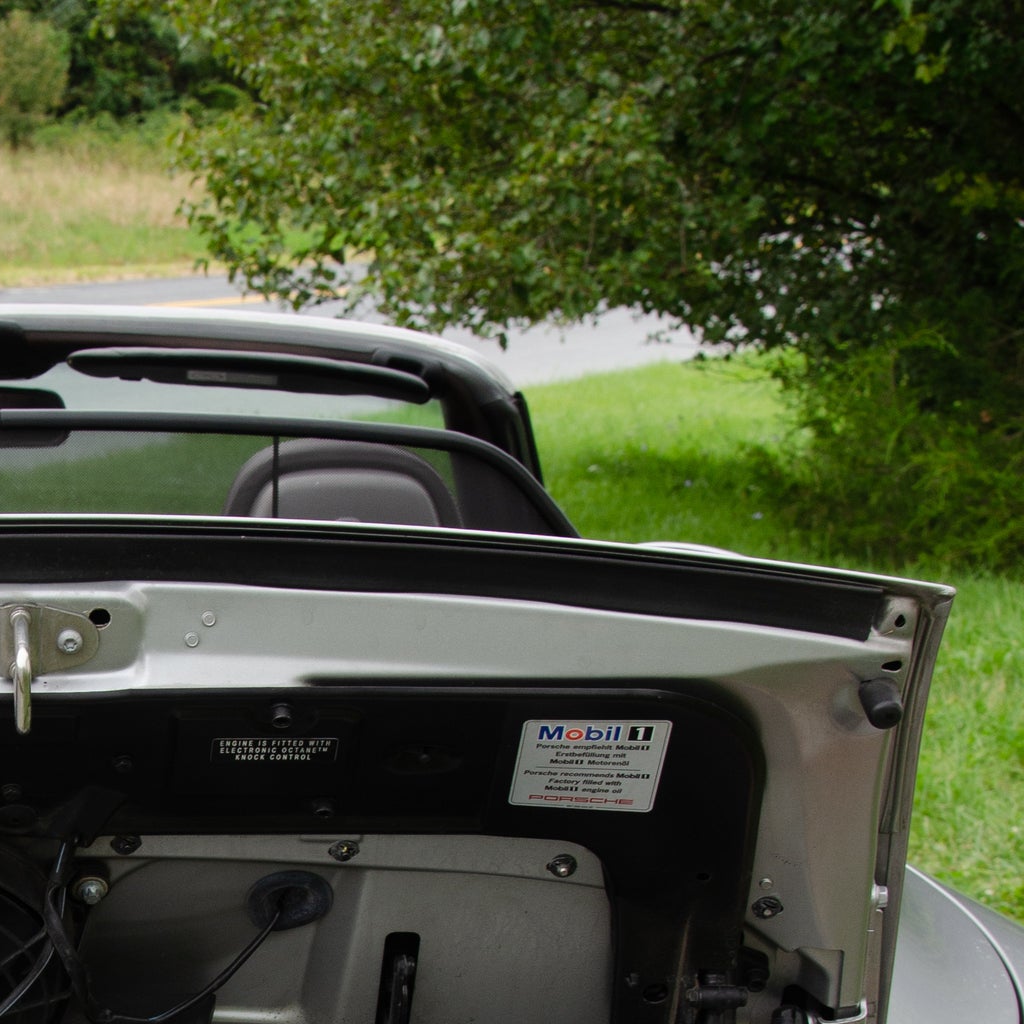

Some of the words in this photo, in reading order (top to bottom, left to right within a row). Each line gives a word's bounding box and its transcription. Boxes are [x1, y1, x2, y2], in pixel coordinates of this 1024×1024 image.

[538, 726, 622, 741] Mobil
[573, 744, 612, 752] empfiehlt
[528, 794, 633, 805] PORSCHE
